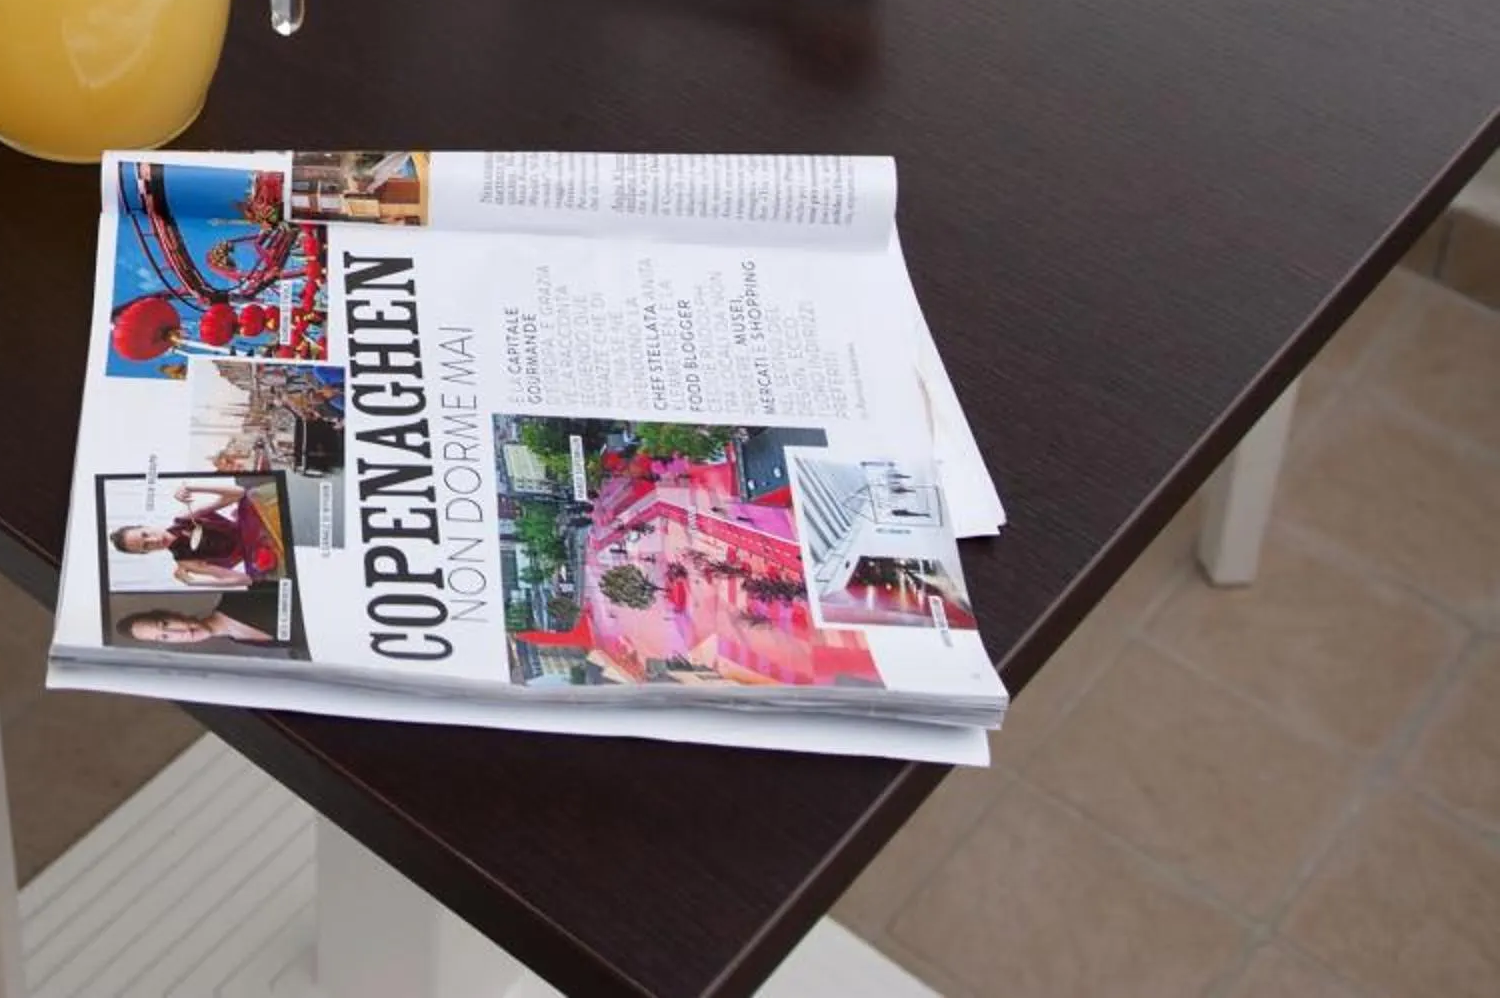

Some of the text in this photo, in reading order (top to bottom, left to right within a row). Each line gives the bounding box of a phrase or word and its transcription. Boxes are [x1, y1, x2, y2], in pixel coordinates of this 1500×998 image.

[730, 296, 746, 346] MUSEI,
[741, 261, 764, 340] SHOPPING
[505, 306, 522, 374] CAPITALE
[522, 313, 542, 404] GOURMANDE
[643, 304, 663, 372] STELLATA
[677, 300, 704, 412] FOOD BLOGGER
[650, 376, 668, 410] CHEF
[755, 357, 776, 414] MERCATI
[343, 252, 452, 660] COPENAGHEN
[438, 327, 488, 622] NON DORME MAI
